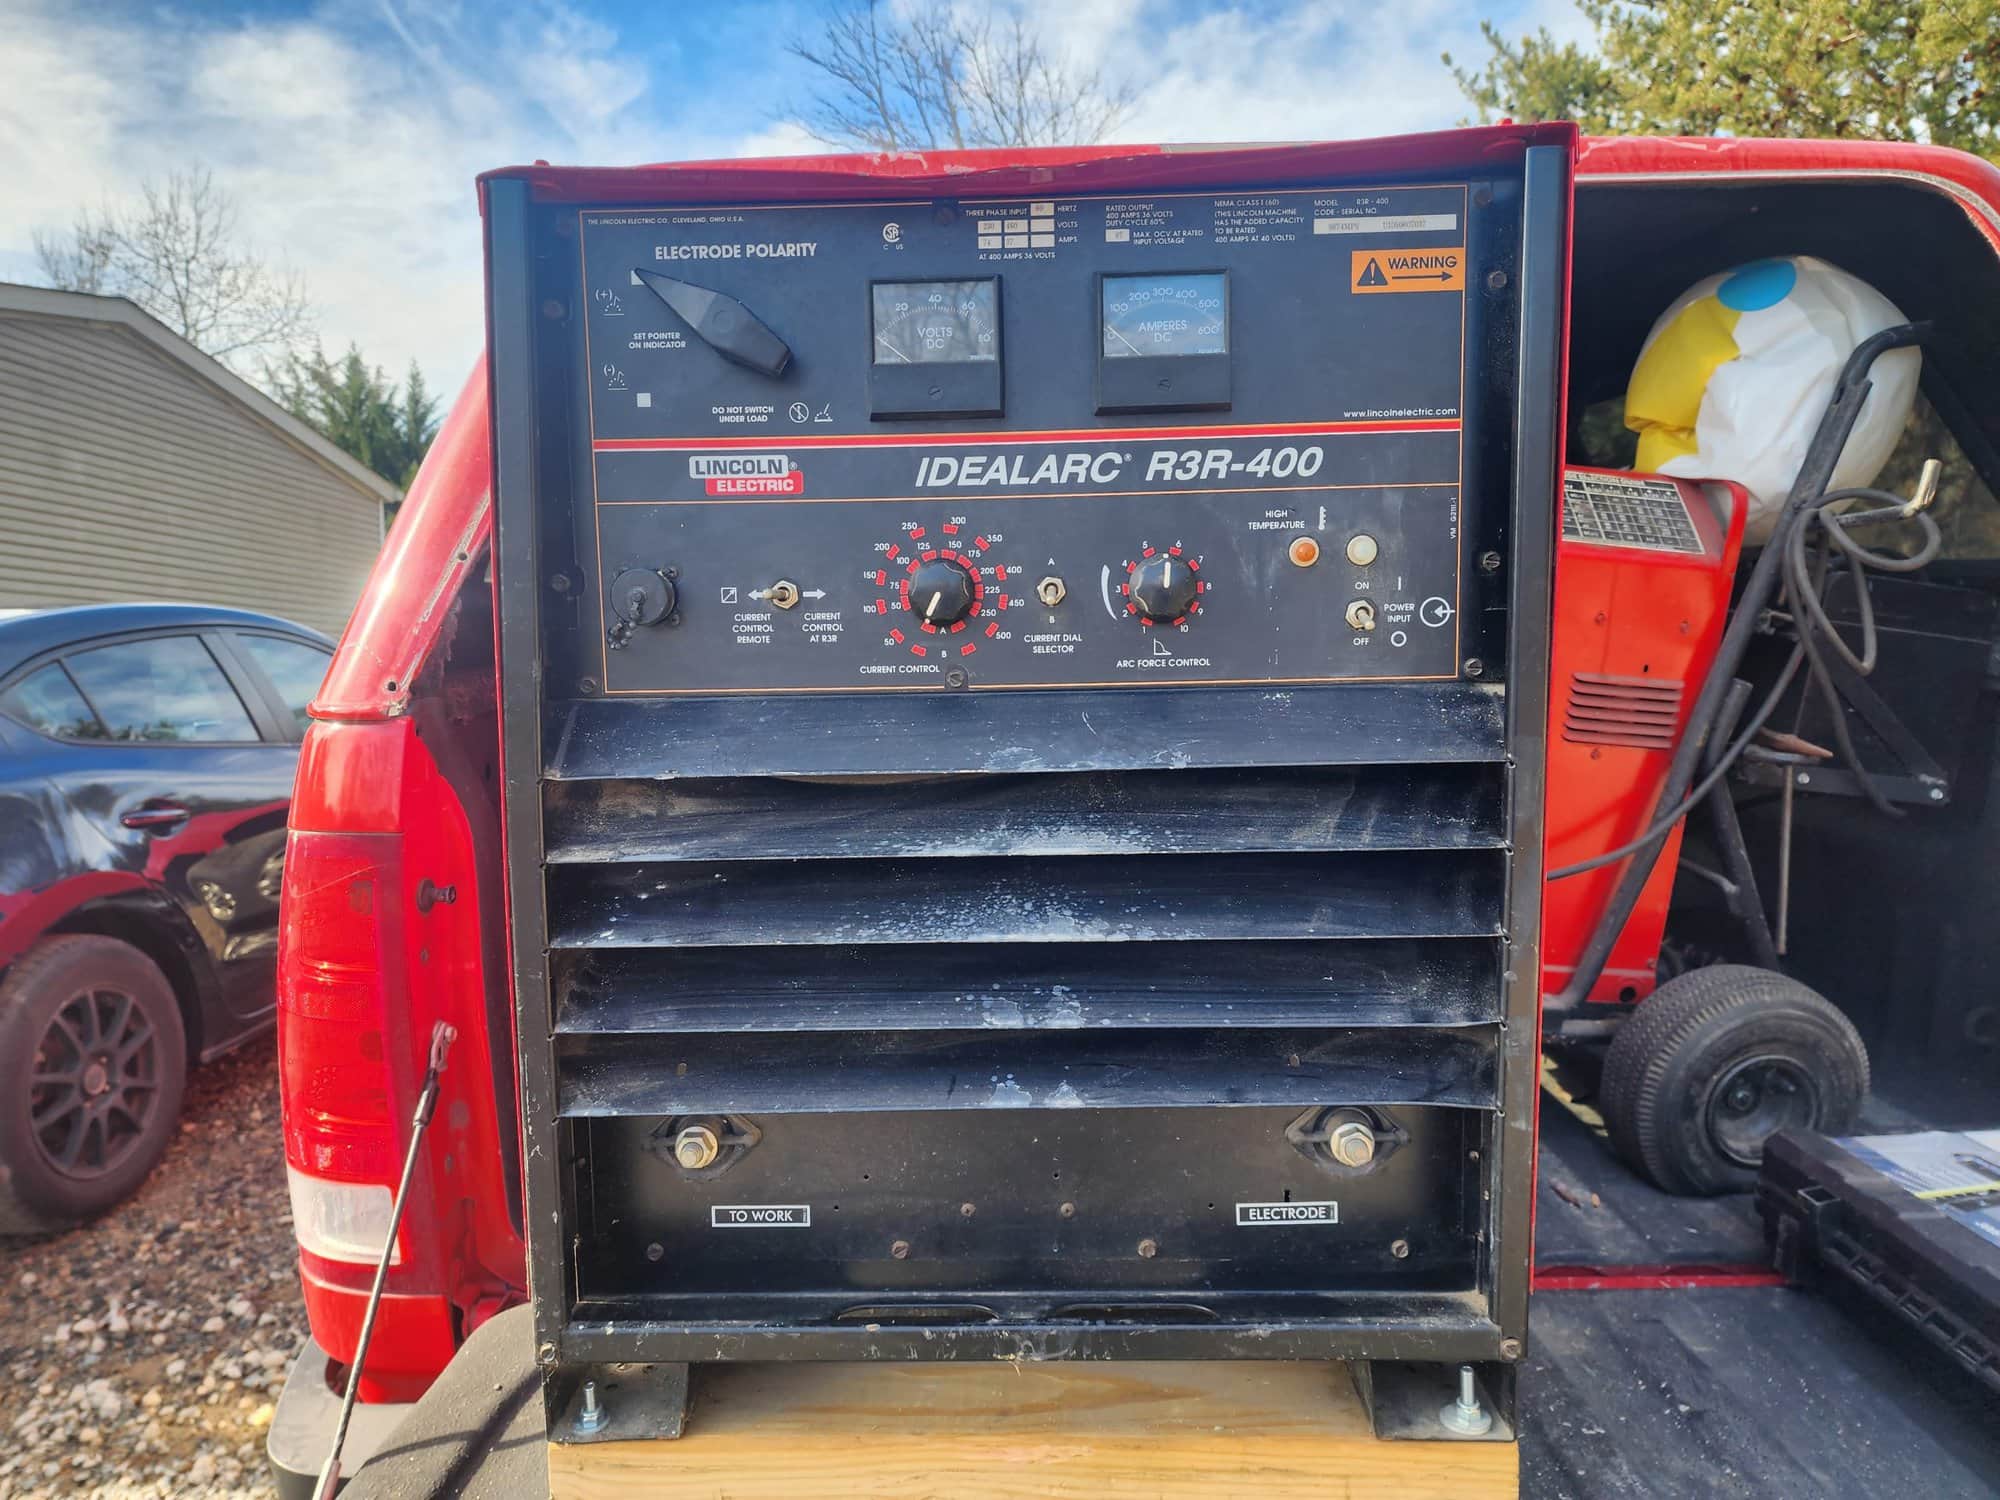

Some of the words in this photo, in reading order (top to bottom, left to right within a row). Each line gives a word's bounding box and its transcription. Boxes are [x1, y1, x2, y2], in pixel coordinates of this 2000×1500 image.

[1314, 199, 1338, 207] MODEL
[1265, 208, 1297, 216] MACHINE
[1314, 208, 1335, 216] CODE
[1244, 217, 1267, 225] ADDED
[1269, 216, 1304, 224] CAPACITY
[1235, 226, 1256, 234] RATED
[1154, 237, 1185, 245] VOLTAGE
[655, 245, 742, 260] ELECTRODE
[745, 243, 817, 258] POLARITY
[1003, 252, 1023, 260] AMPS
[1388, 256, 1457, 270] WARNING
[1152, 287, 1174, 297] 300
[1175, 289, 1197, 299] 400
[928, 294, 942, 303] 40
[1129, 292, 1150, 302] 200
[895, 302, 909, 312] 20
[961, 302, 975, 312] 60
[1110, 303, 1128, 313] 100
[1199, 299, 1219, 309] 500
[1138, 320, 1187, 332] AMPERES
[1198, 325, 1219, 335] 600
[633, 332, 646, 341] SET
[647, 332, 681, 340] POINTER
[917, 327, 953, 338] VOLTS
[1154, 332, 1171, 342] DC
[628, 341, 641, 350] ON
[643, 340, 686, 349] INDICATOR
[926, 339, 945, 349] DC
[712, 406, 723, 414] DO
[725, 406, 743, 414] NOT
[745, 405, 774, 414] SWITCH
[1344, 407, 1457, 418] www.lincolnelectric.com
[719, 414, 745, 423] UNDER
[746, 414, 768, 423] LOAD
[1145, 446, 1324, 482] R3R-400
[716, 479, 795, 493] ELECTRIC
[1265, 510, 1288, 518] HIGH
[902, 522, 917, 530] 250
[1248, 521, 1305, 530] TEMPERATURE
[874, 543, 890, 551] 200
[1142, 541, 1148, 549] 5
[1176, 540, 1182, 548] 6
[968, 550, 981, 558] 175
[980, 567, 995, 575] 200
[1006, 566, 1022, 574] 400
[864, 571, 876, 579] 150
[1206, 582, 1212, 590] 8
[1354, 582, 1369, 590] ON
[891, 602, 901, 610] 50
[1009, 599, 1024, 607] 450
[1384, 603, 1415, 612] POWER
[864, 605, 876, 613] 100
[981, 609, 996, 617] 250
[1198, 608, 1204, 616] 9
[734, 613, 771, 622] CURRENT
[804, 612, 841, 621] CURRENT
[1122, 610, 1128, 618] 2
[1387, 615, 1411, 623] INPUT
[732, 624, 774, 633] CONTROL
[802, 623, 844, 632] CONTROL
[1142, 626, 1146, 634] 1
[1180, 625, 1189, 633] 10
[737, 635, 771, 644] REMOTE
[810, 634, 820, 643] AT
[822, 634, 837, 643] R3R
[884, 638, 895, 646] 50
[1024, 634, 1061, 643] CURRENT
[1063, 633, 1083, 642] DIAL
[1353, 638, 1369, 646] OFF
[1033, 645, 1074, 654] SELECTOR
[1116, 659, 1136, 668] ARC
[1138, 659, 1166, 668] FORCE
[1168, 658, 1211, 667] CONTROL
[860, 665, 896, 674] CURRENT
[898, 664, 940, 674] CONTROL
[729, 1210, 748, 1222] TO
[752, 1210, 793, 1222] WORK
[1249, 1207, 1327, 1220] ELECTRODE
